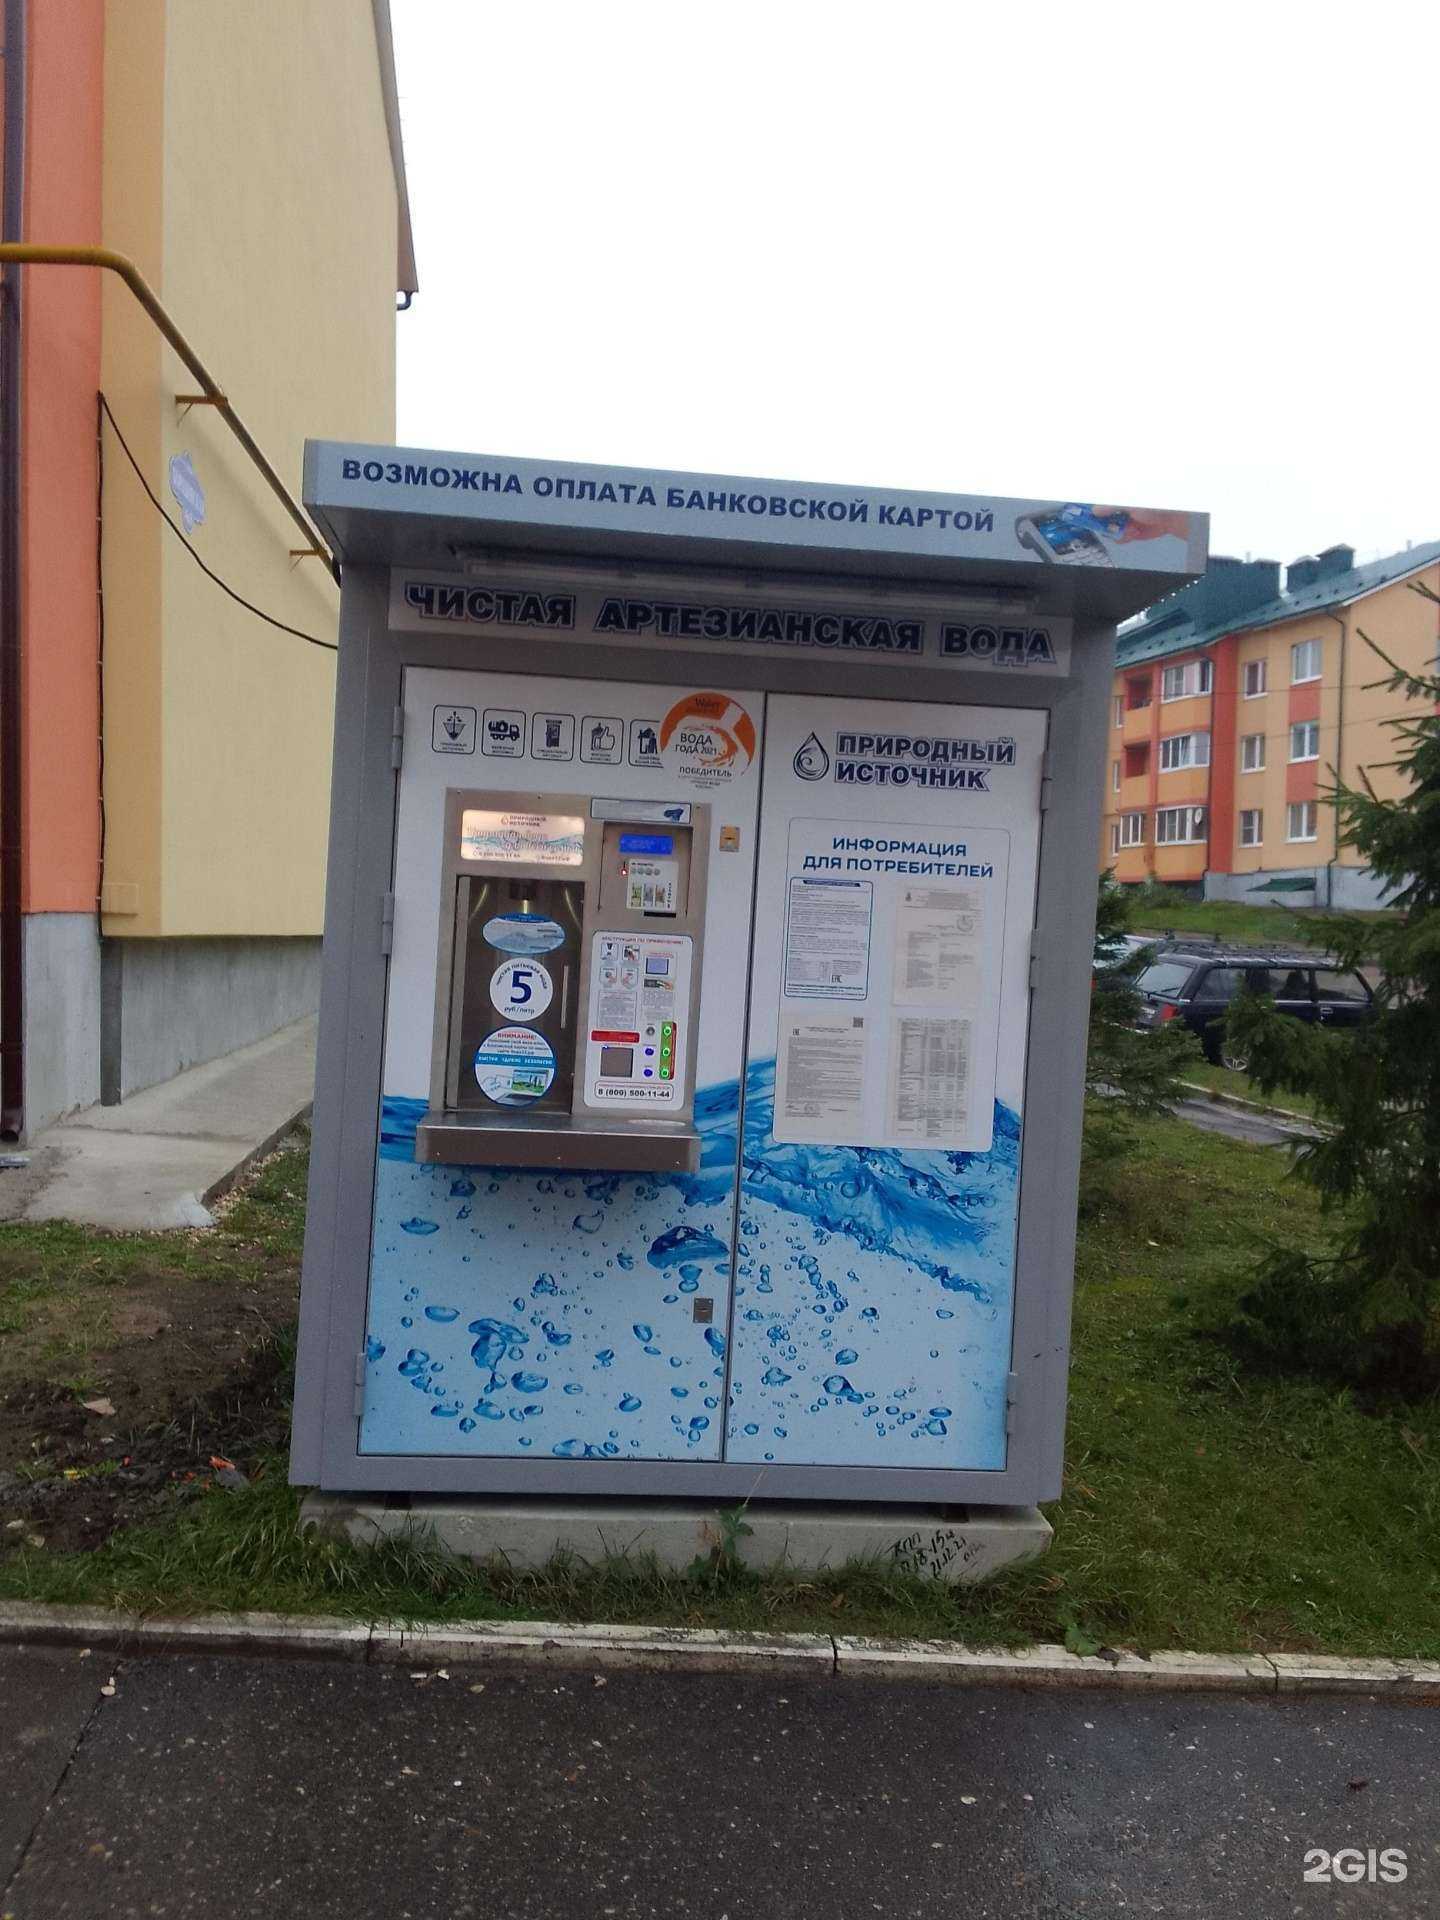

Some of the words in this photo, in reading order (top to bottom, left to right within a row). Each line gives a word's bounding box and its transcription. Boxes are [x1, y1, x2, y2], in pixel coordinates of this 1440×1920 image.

[342, 458, 523, 495] ВОЗМОЖНА
[532, 477, 657, 507] ОПЛАТА
[666, 486, 868, 524] БАНКОВСКОЙ
[878, 502, 995, 533] КАРТОЙ
[405, 582, 576, 629] ЧИСТАЯ
[593, 598, 925, 656] АРТЕЗИАНСКАЯ
[940, 622, 1056, 667] ВОДА
[675, 744, 698, 755] ГОДА
[680, 733, 712, 746] ВОДА
[835, 732, 1016, 766] ПРИРОДНЫЙ
[679, 766, 733, 778] ПОБЕДИТЕЛЬ
[834, 760, 990, 792] ИСТОЧНИК
[832, 837, 967, 858] ИНФОРМАЦИЯ
[803, 856, 842, 870] ДЛЯ
[847, 858, 993, 878] ПОТРЕБИТЕЛЕЙ
[511, 970, 532, 1004] 5
